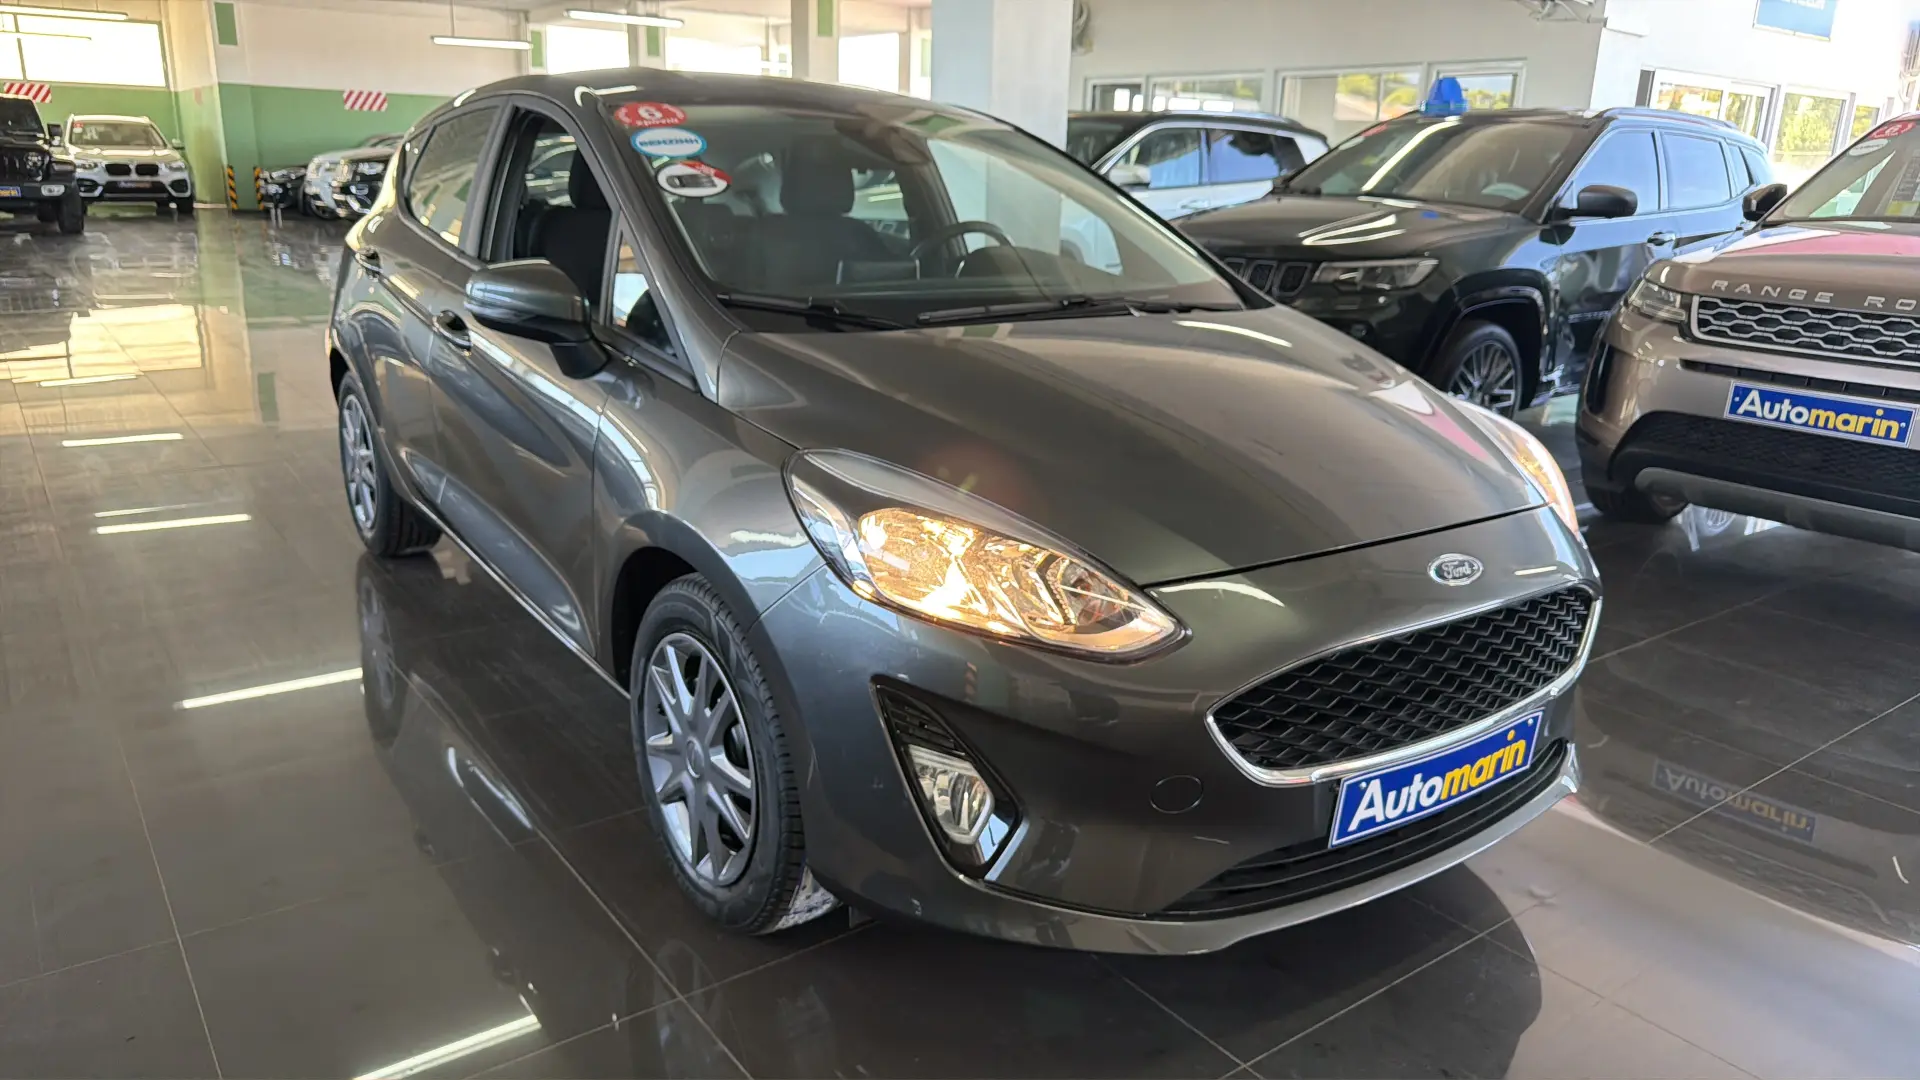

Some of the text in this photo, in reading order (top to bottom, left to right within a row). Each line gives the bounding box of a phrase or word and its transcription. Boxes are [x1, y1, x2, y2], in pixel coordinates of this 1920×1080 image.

[1711, 280, 1834, 304] RANGE
[1736, 389, 1900, 439] Automarin
[1441, 560, 1472, 579] Ford
[1347, 729, 1527, 832] Automarin
